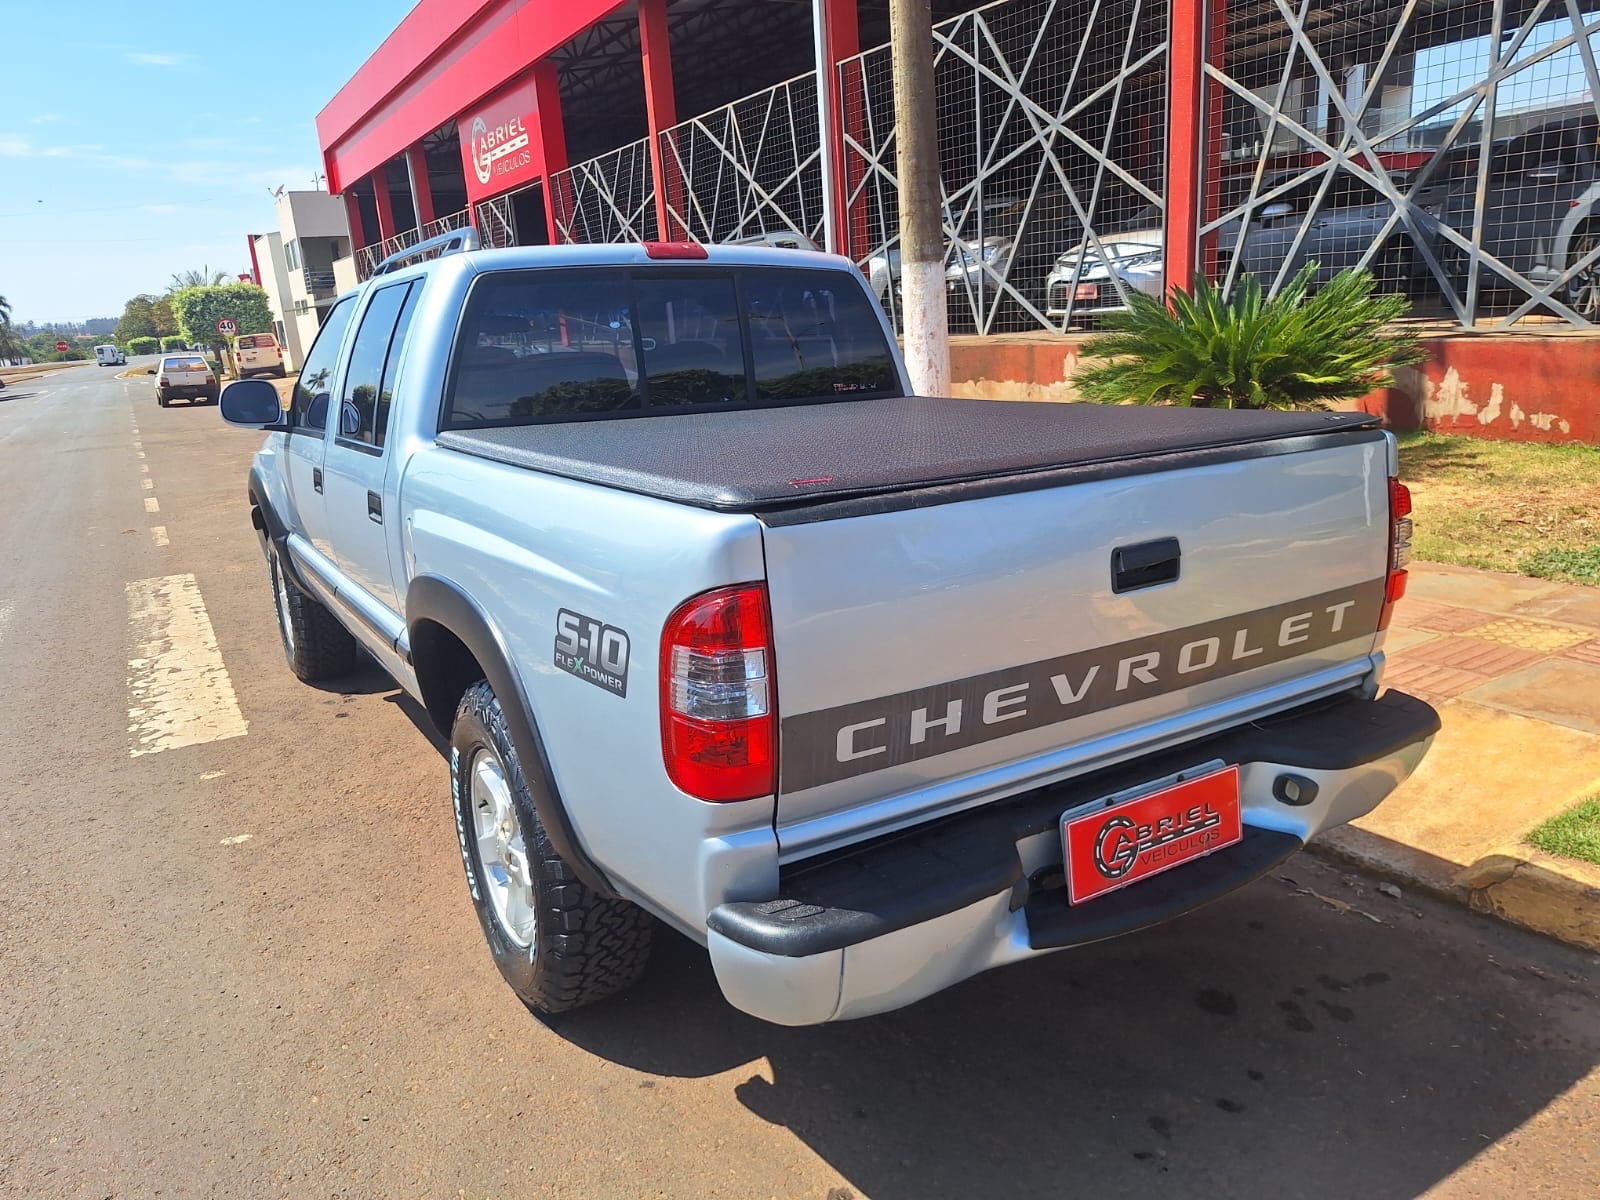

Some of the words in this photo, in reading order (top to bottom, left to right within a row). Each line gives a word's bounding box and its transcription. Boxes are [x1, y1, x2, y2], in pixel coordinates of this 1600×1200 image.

[220, 321, 233, 330] 40
[557, 612, 628, 676] S-10
[837, 600, 1356, 763] CHEVROLET
[1140, 828, 1220, 865] VEICULOS
